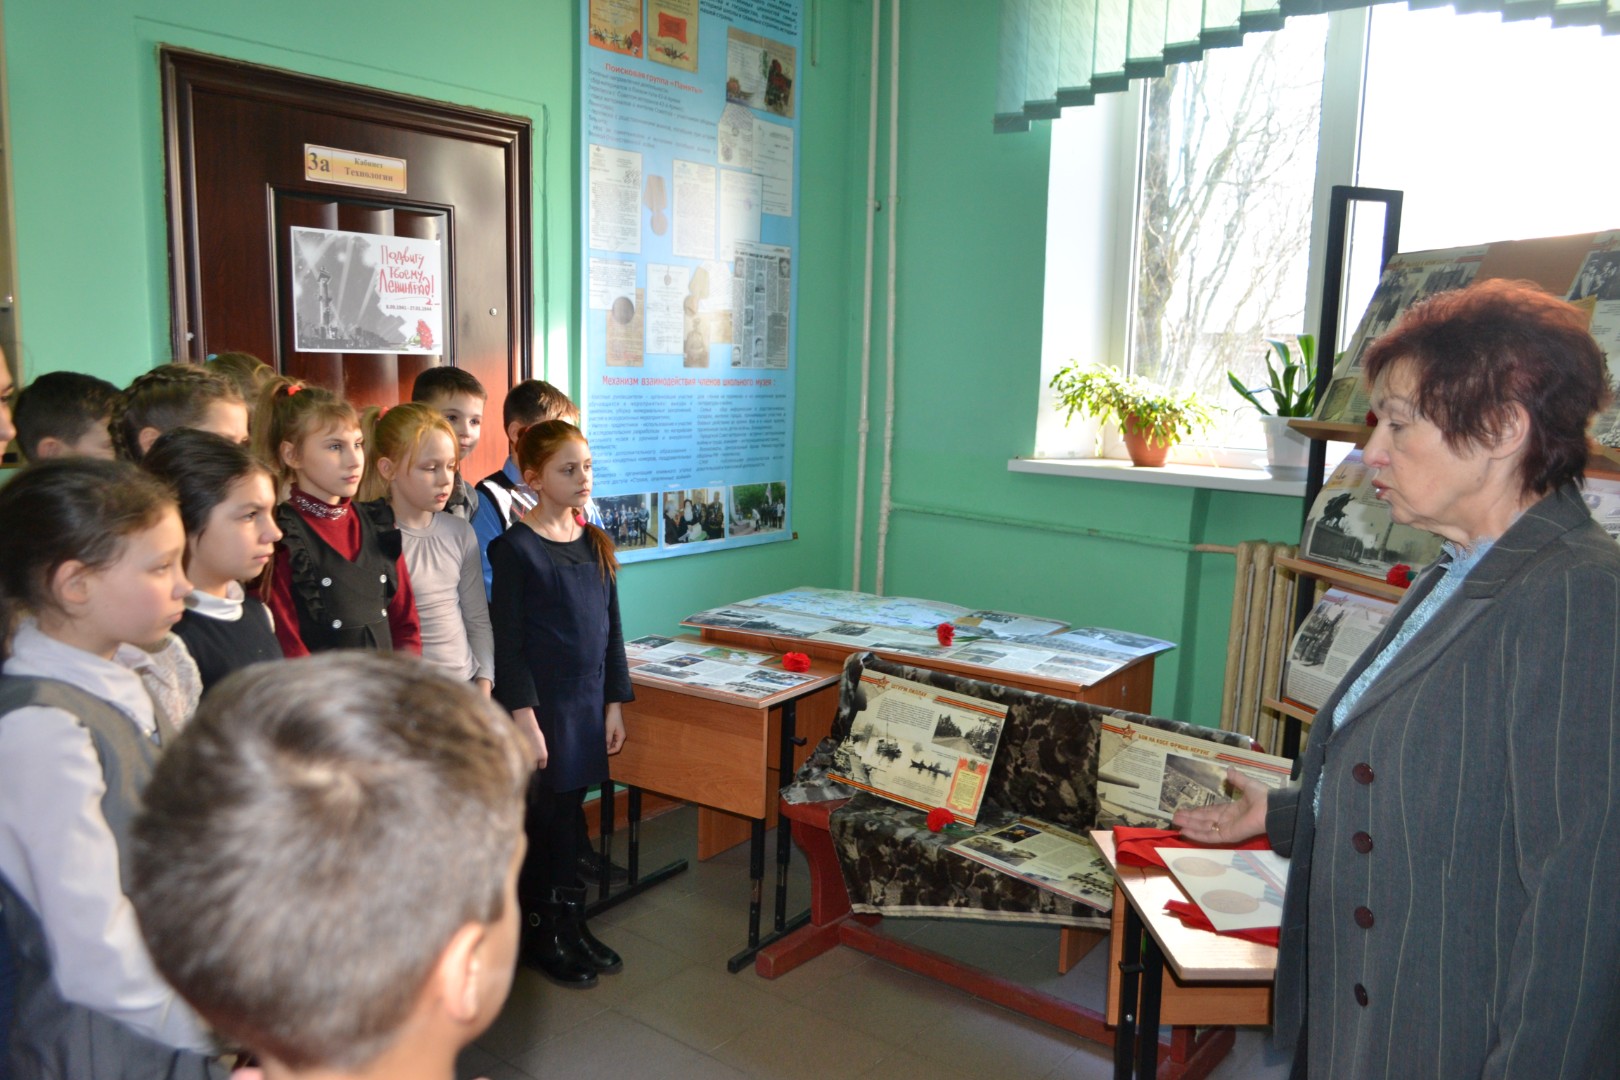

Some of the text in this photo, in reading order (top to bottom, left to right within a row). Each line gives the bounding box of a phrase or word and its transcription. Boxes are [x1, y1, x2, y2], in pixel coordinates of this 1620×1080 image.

[605, 63, 646, 79] Поисковая
[646, 73, 669, 87] группа
[307, 152, 330, 173] 3а
[354, 157, 383, 169] Кабинет
[344, 167, 393, 182] Технологии
[602, 375, 639, 386] Механизм
[641, 376, 696, 387] взаимодействия
[698, 378, 721, 386] членов
[723, 378, 753, 386] школьного
